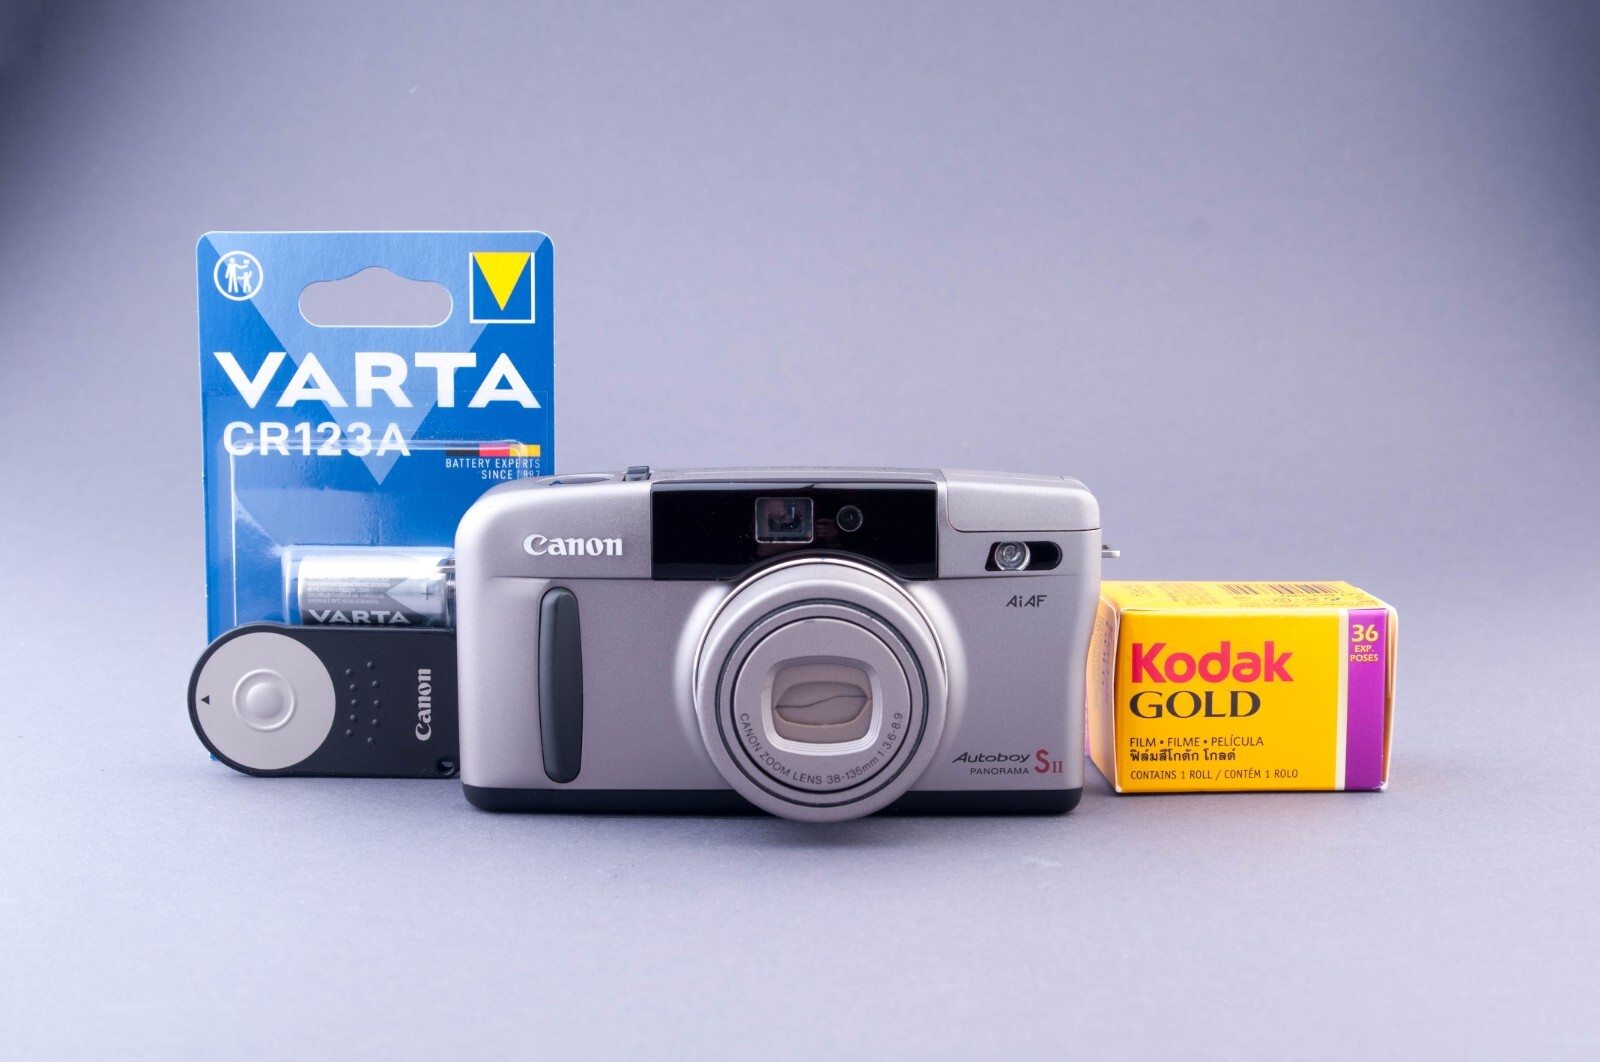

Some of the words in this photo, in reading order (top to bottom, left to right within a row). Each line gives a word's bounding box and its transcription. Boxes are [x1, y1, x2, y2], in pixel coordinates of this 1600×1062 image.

[213, 352, 542, 409] VARTA
[223, 421, 411, 457] CR123A
[445, 458, 491, 469] BATTERY
[495, 458, 541, 469] EXPERTS
[481, 469, 513, 480] SINCE
[523, 534, 623, 556] Canon
[307, 609, 411, 624] VARTA
[1351, 624, 1379, 643] 36
[1354, 645, 1374, 653] EXP.
[1131, 641, 1295, 684] Kodak
[1350, 654, 1379, 663] POSES
[415, 668, 432, 741] Canon
[1129, 690, 1261, 719] GOLD
[1129, 737, 1156, 747] FILM
[1167, 737, 1200, 747] FILME
[1211, 734, 1264, 747] PELÍCULA
[740, 713, 763, 753] CANON
[759, 751, 791, 777] ZOOM
[792, 773, 823, 785] LENS
[826, 756, 879, 785] 38-135mm
[952, 752, 1030, 763] Autoboy
[970, 767, 1030, 775] PANORAMA
[1130, 770, 1177, 780] CONTAINS
[1181, 772, 1185, 780] 1
[1189, 770, 1213, 779] ROLL
[1224, 767, 1261, 779] CONTÉM
[1265, 770, 1270, 779] 1
[1274, 769, 1298, 779] ROLO
